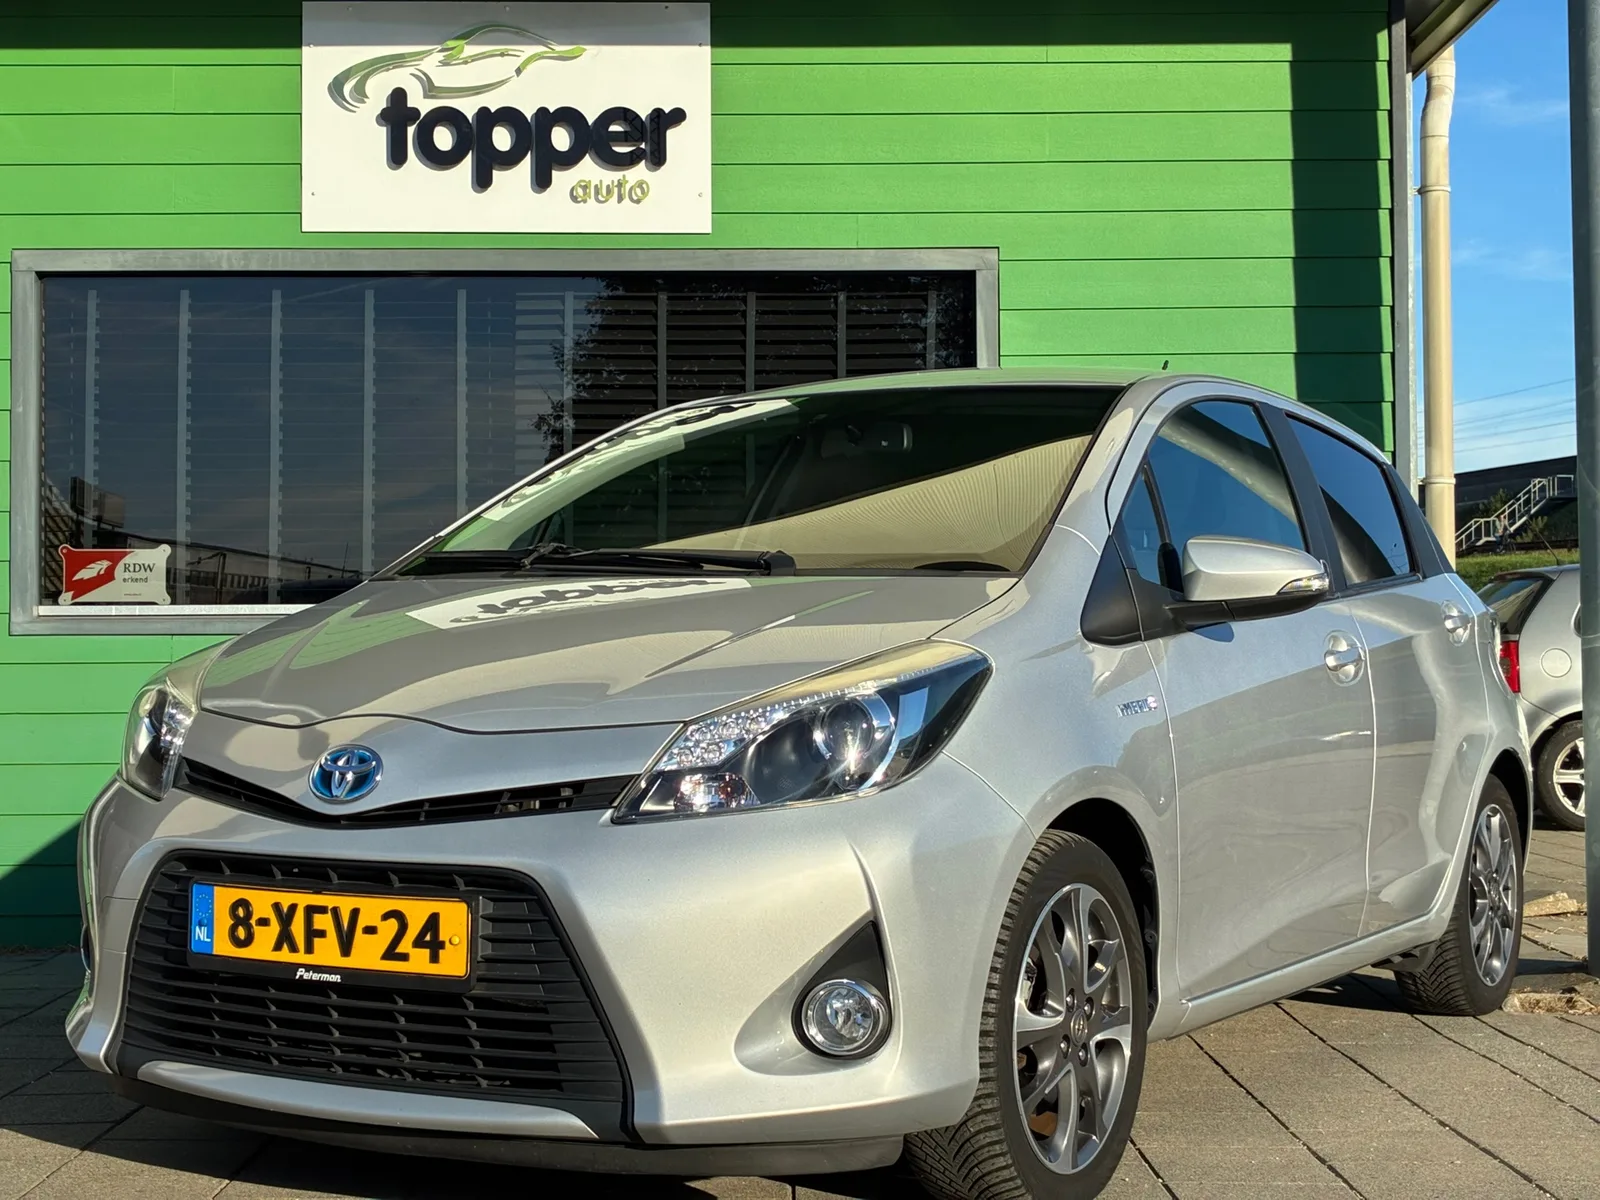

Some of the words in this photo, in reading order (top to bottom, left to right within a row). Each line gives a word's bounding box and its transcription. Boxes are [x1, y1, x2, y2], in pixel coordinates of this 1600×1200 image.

[379, 87, 687, 190] topper
[573, 174, 650, 203] auto
[123, 562, 156, 573] RDW
[122, 576, 149, 584] erkend
[195, 926, 211, 942] NL
[228, 898, 446, 964] 8-XFV-24
[295, 967, 342, 983] Peterman
